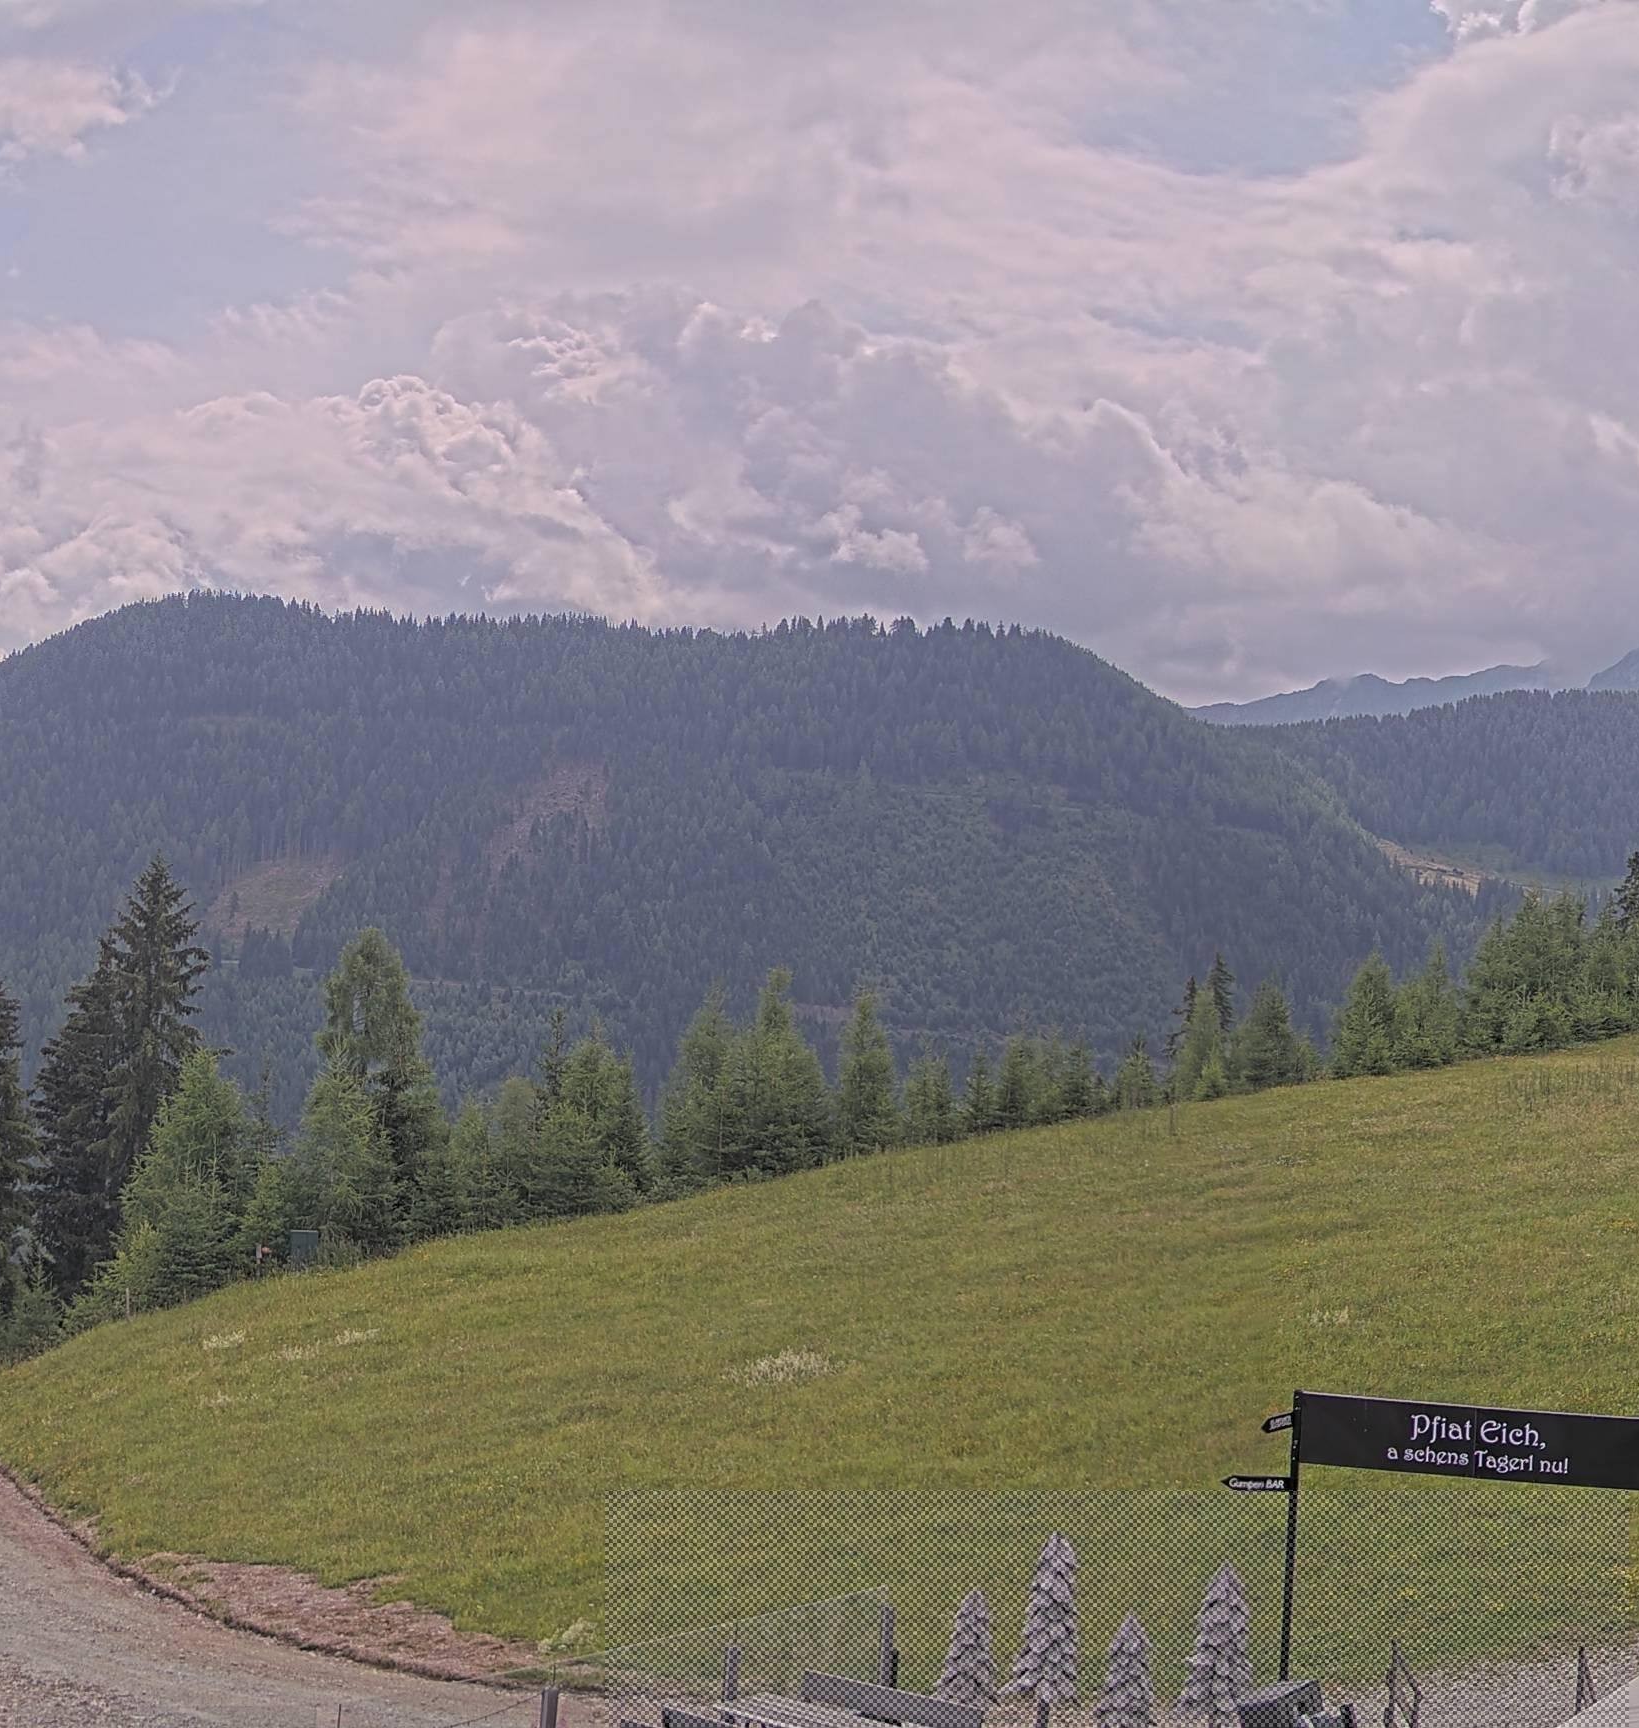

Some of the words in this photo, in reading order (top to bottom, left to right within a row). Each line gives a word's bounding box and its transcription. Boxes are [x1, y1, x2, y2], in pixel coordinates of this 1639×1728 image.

[1410, 1414, 1472, 1444] Pfiat
[1480, 1420, 1546, 1450] Eich,
[1387, 1447, 1399, 1461] a
[1403, 1446, 1470, 1467] schens
[1474, 1450, 1534, 1474] Tagerl
[1539, 1457, 1570, 1475] nu!
[1266, 1479, 1285, 1489] BAR
